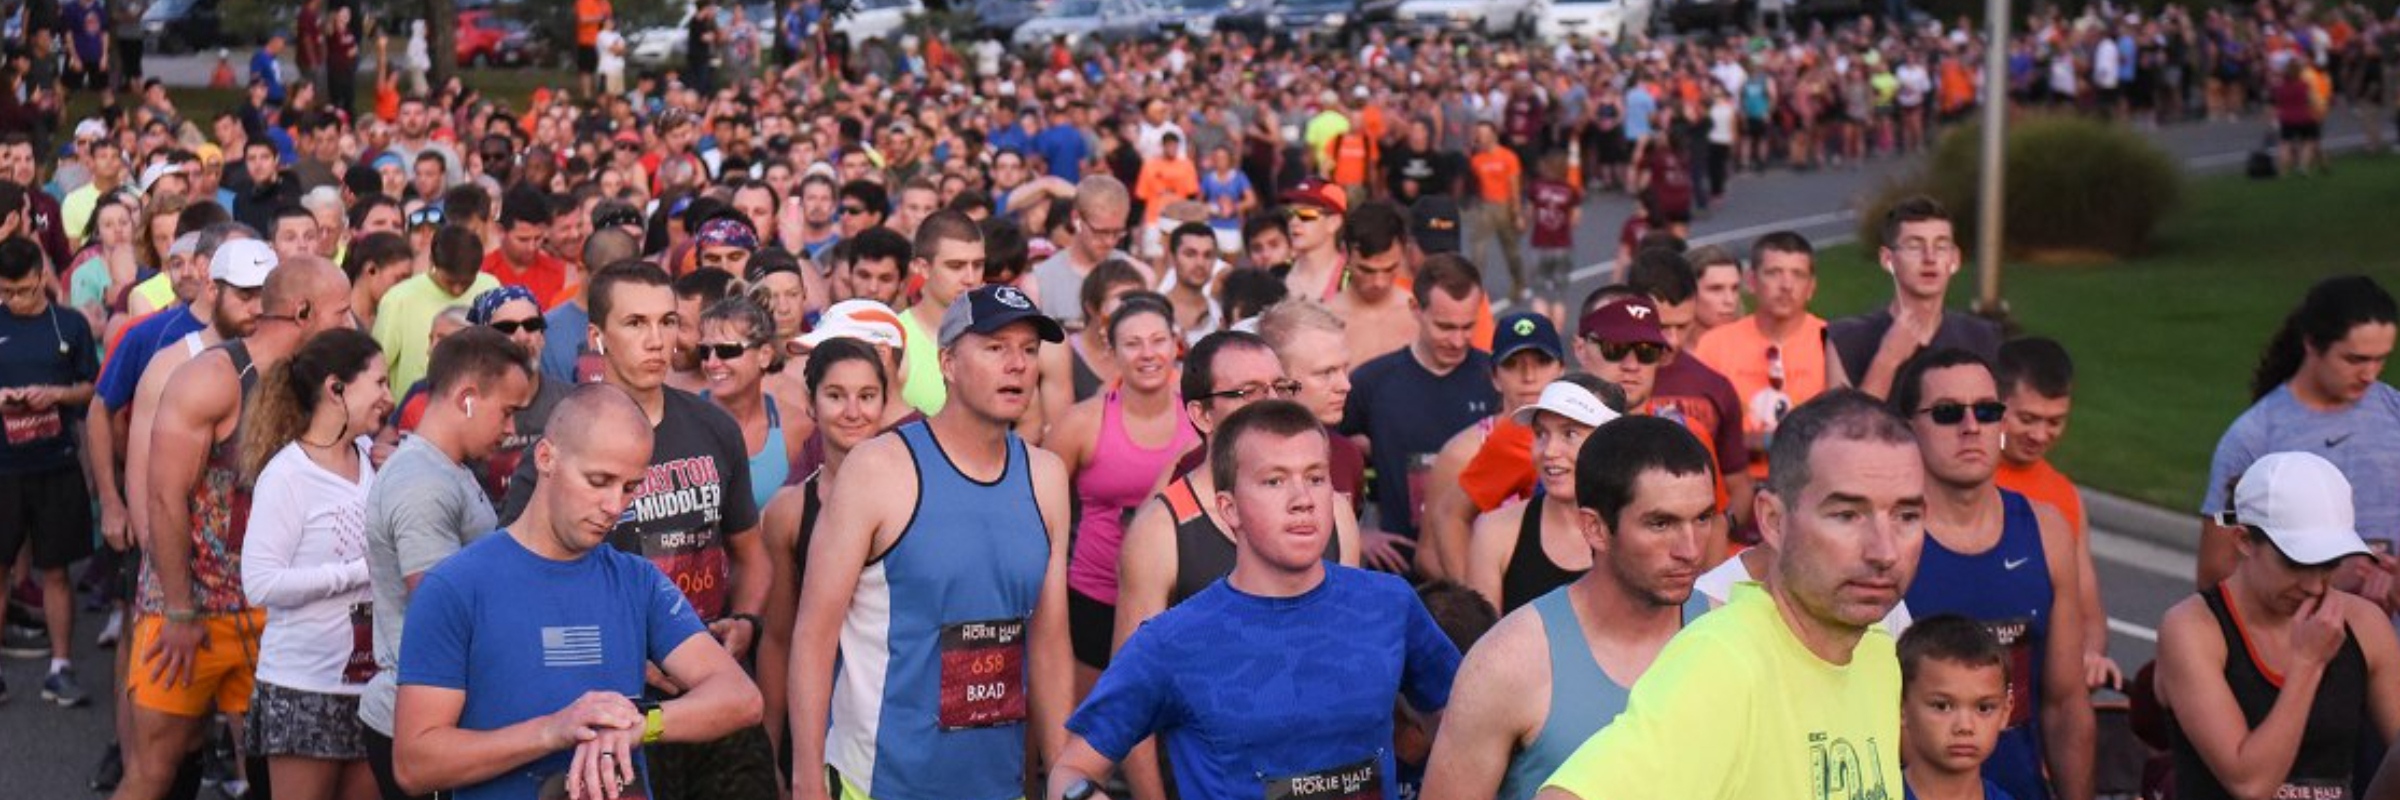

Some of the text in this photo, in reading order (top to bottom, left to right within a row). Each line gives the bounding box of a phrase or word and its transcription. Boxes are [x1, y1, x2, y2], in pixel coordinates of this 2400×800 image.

[971, 653, 1004, 675] 658
[967, 682, 1005, 701] BRAD
[1292, 776, 1339, 796] HOKIE
[1341, 767, 1373, 785] HALF
